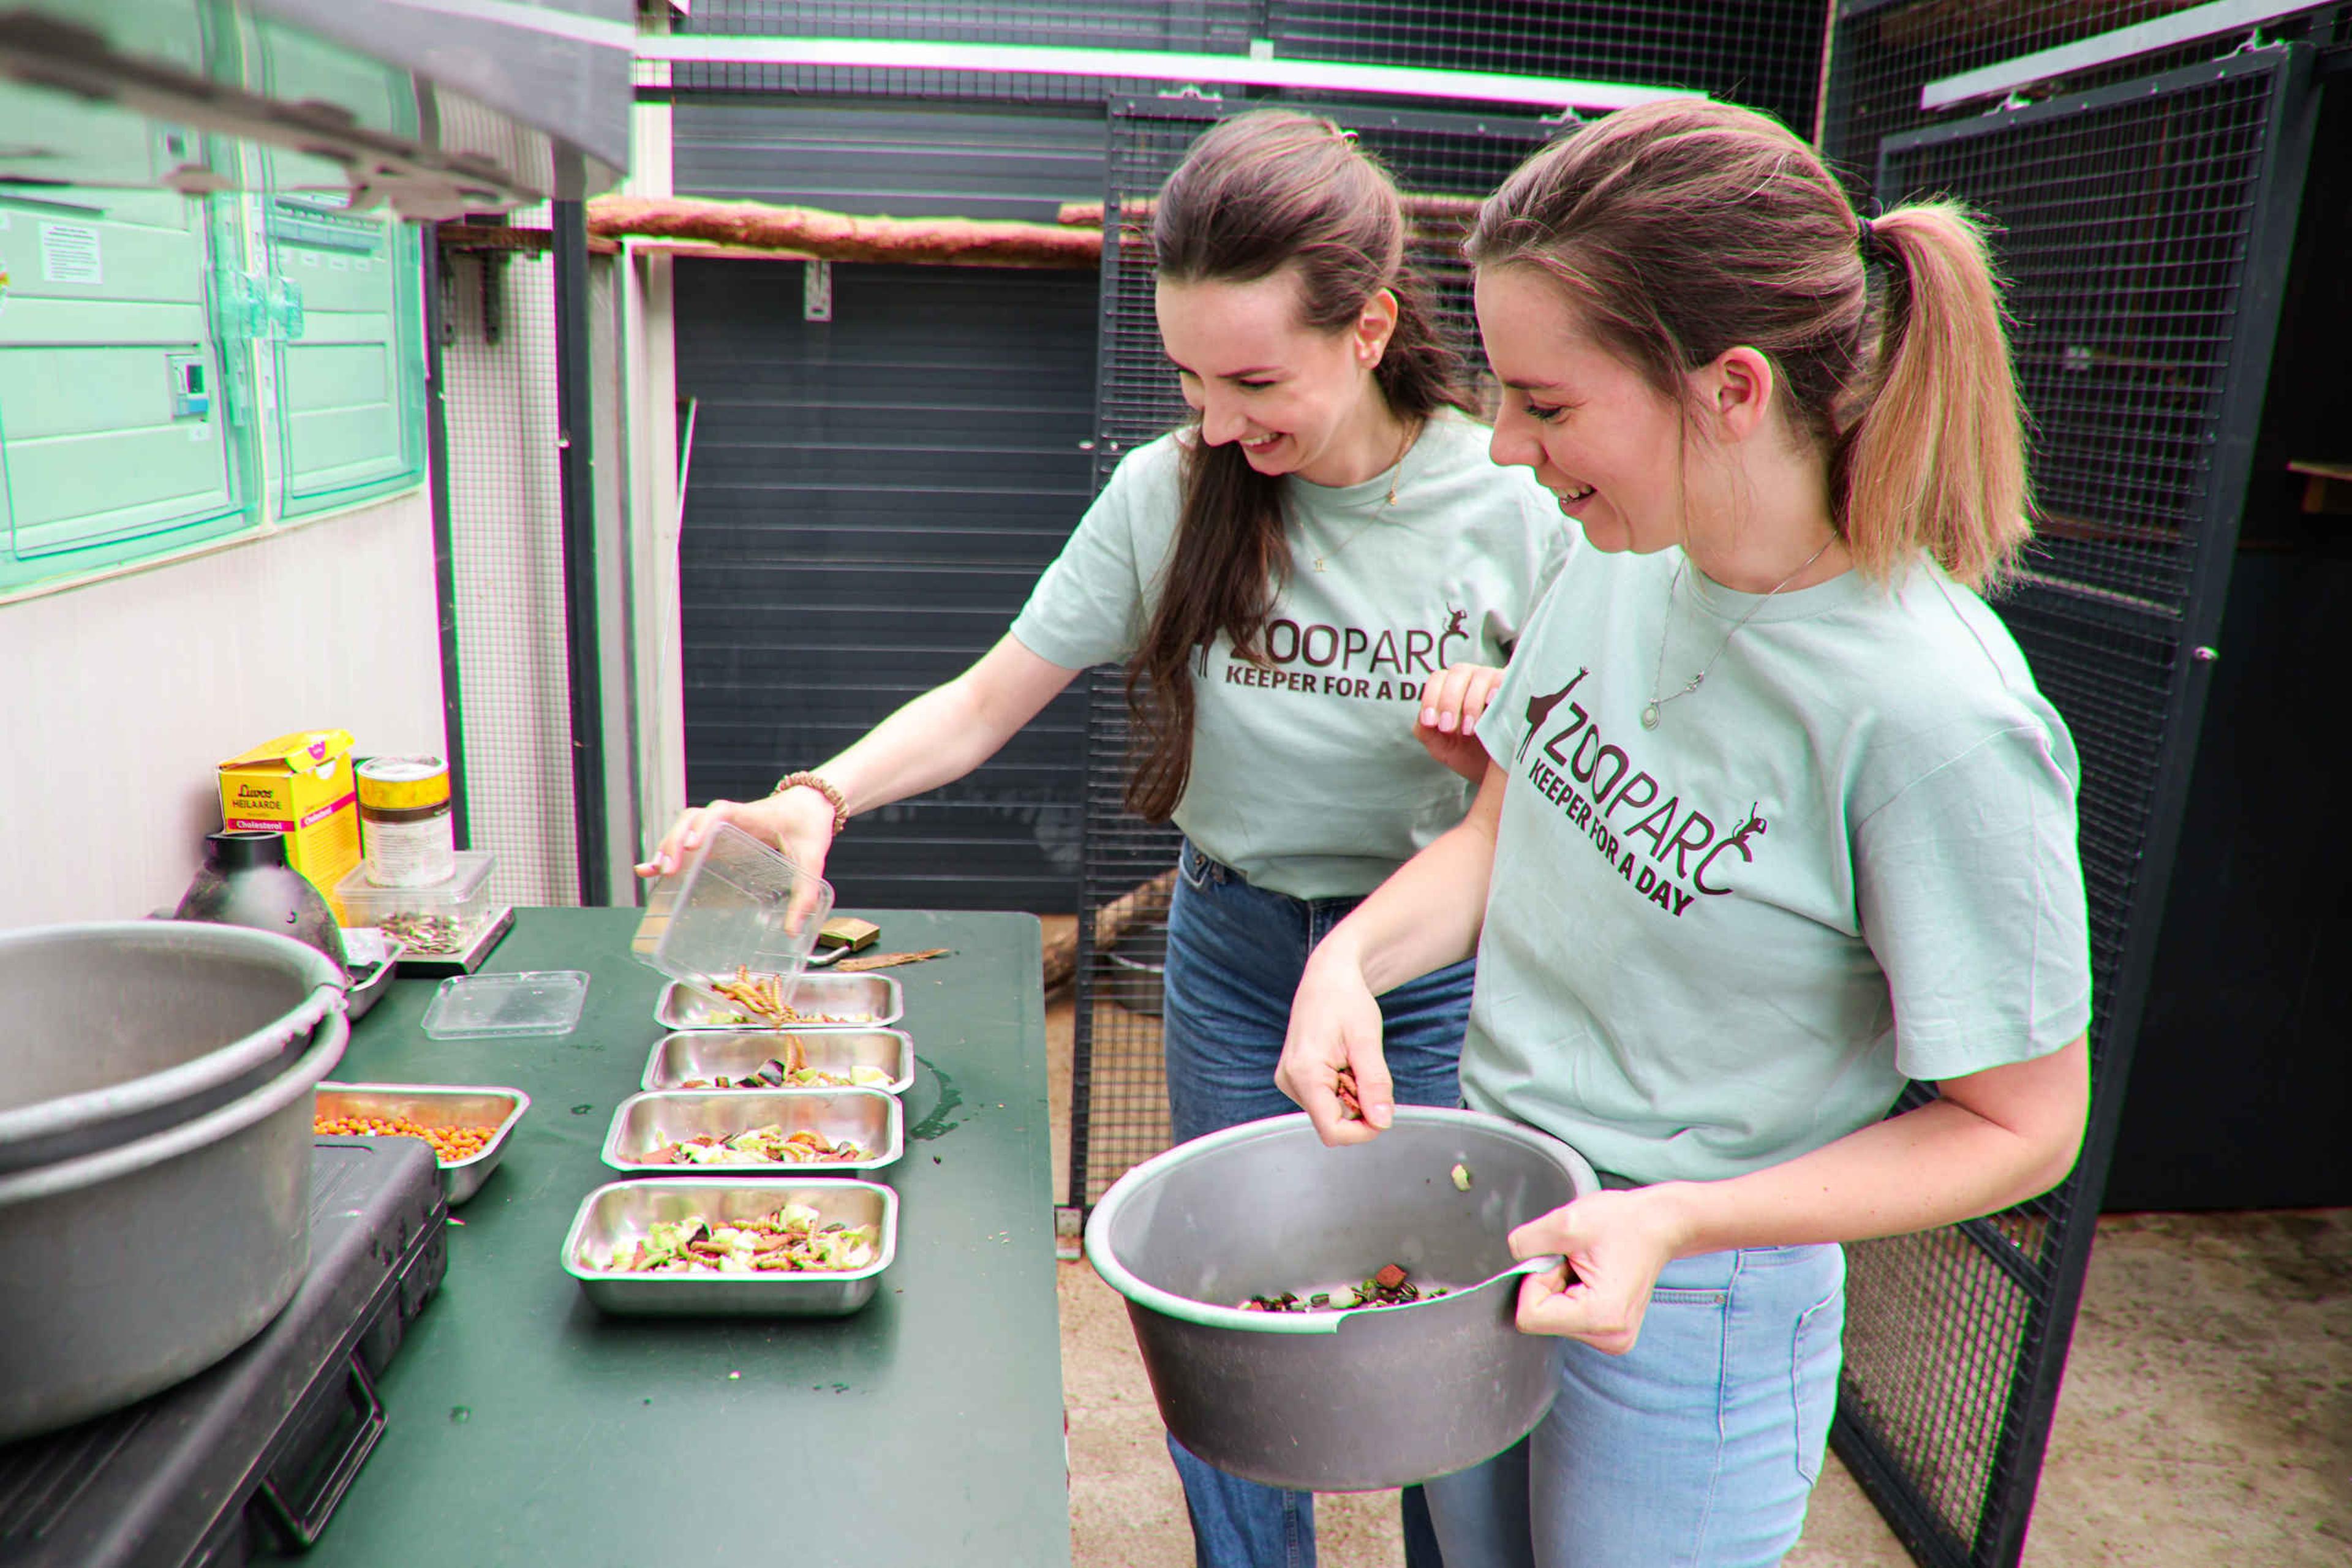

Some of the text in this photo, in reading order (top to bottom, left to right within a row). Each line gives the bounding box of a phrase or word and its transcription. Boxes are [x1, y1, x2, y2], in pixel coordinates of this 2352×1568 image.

[1230, 619, 1469, 674] OOPARC
[1226, 665, 1317, 693] KEEPER
[1324, 676, 1369, 698] FOR
[1376, 680, 1393, 699] A
[236, 820, 283, 831] Cholesterol
[1543, 701, 1754, 896] ZOOPARC
[1529, 758, 1695, 917] KEEPER FOR A DAY
